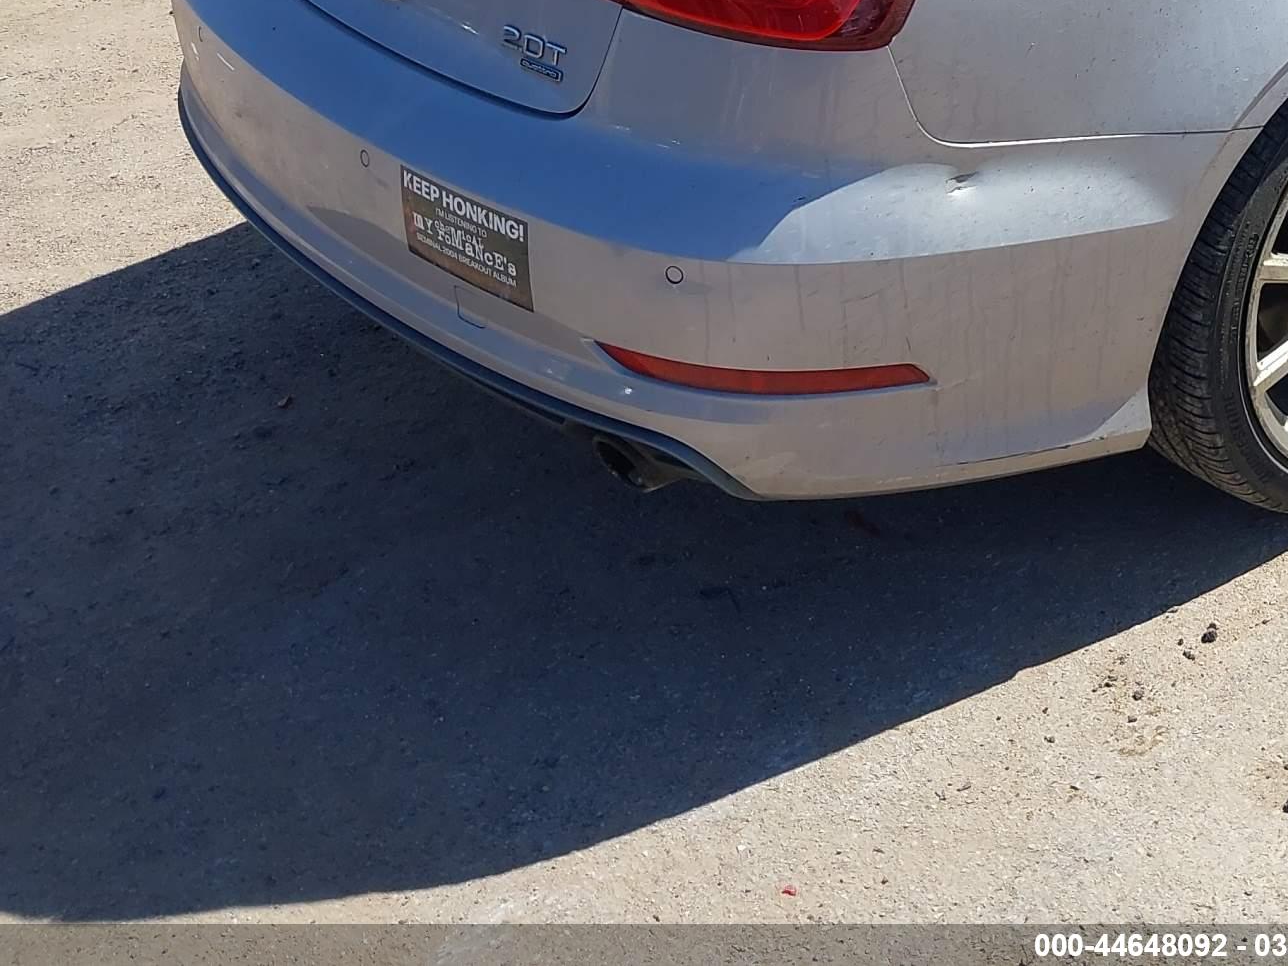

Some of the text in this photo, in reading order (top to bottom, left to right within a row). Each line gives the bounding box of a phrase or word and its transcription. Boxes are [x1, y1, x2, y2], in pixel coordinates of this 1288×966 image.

[403, 170, 524, 242] KEEP HONKING!
[478, 227, 487, 237] TO
